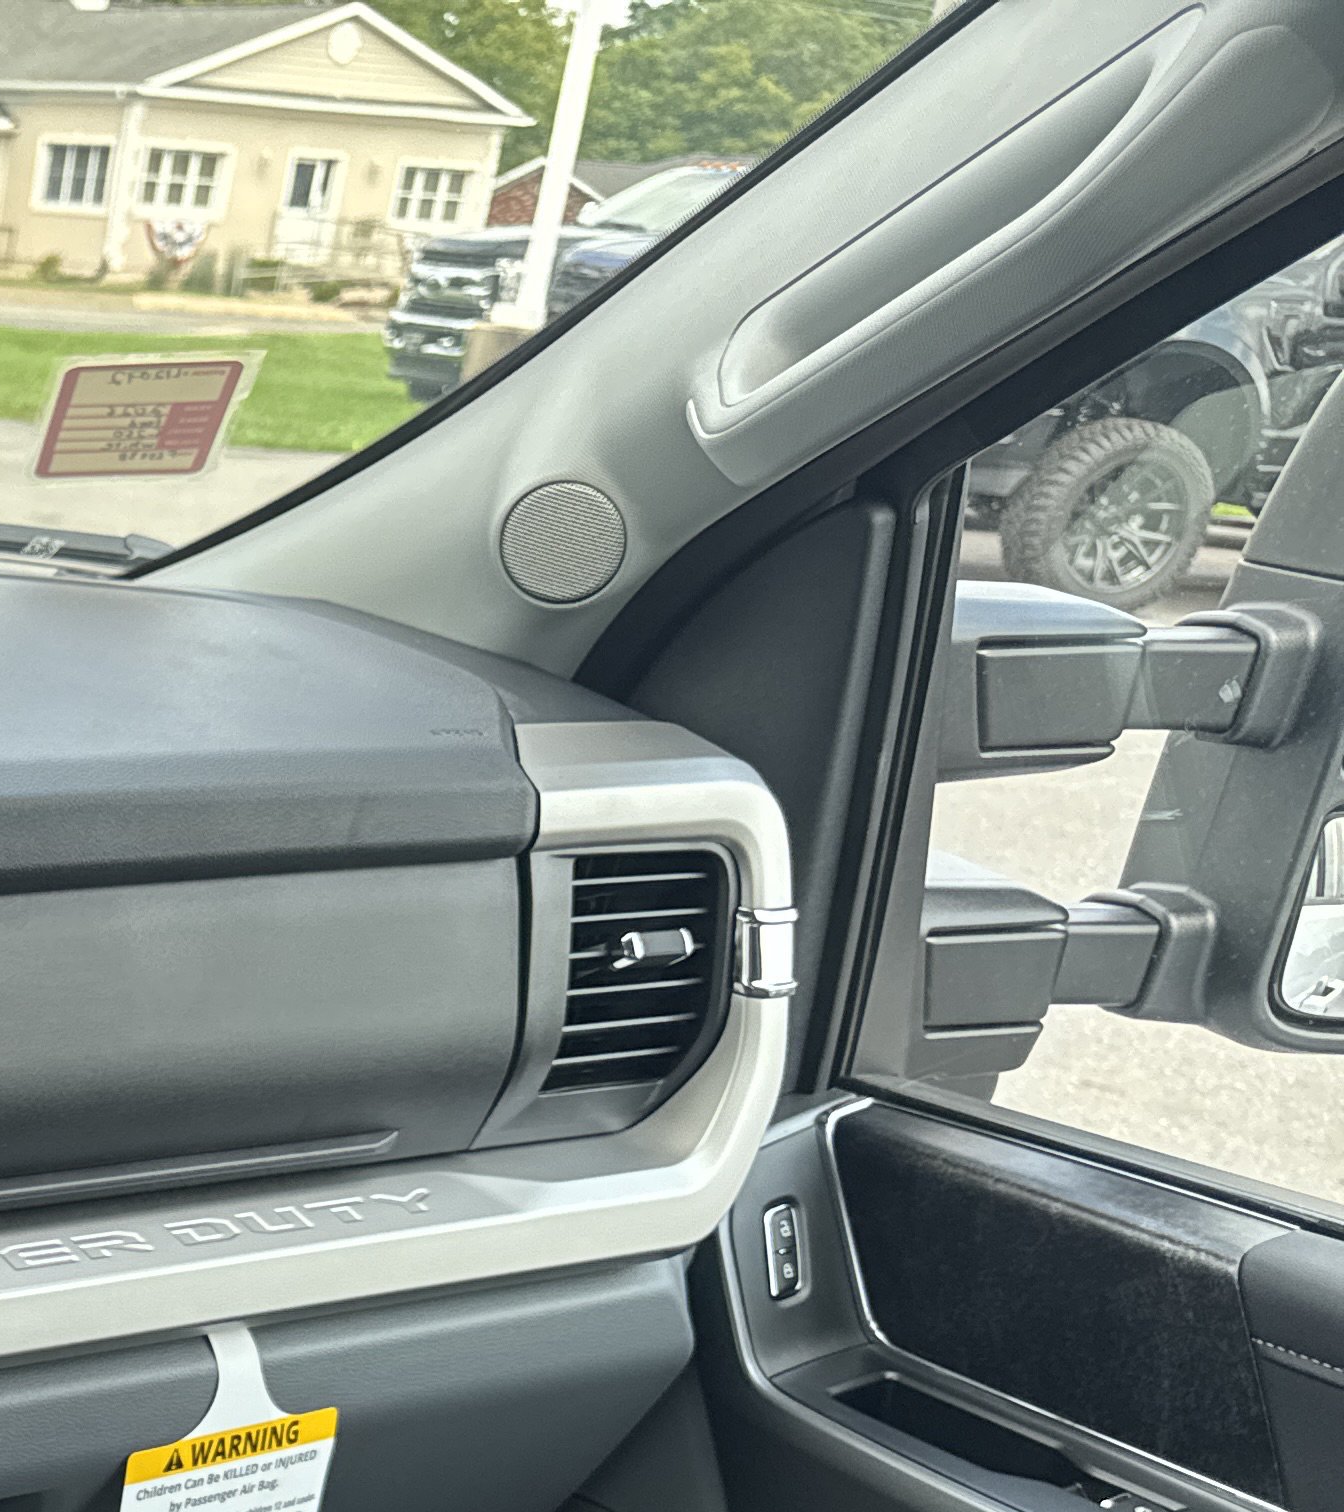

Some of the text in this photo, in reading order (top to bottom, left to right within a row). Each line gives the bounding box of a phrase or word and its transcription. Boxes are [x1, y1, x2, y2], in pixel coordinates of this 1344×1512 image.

[163, 1186, 433, 1246] DUTY
[191, 1420, 300, 1467] WARNING
[136, 1449, 318, 1501] Children Can Be KILLED or INJURED
[184, 1487, 239, 1509] Passenger
[240, 1482, 256, 1495] Air
